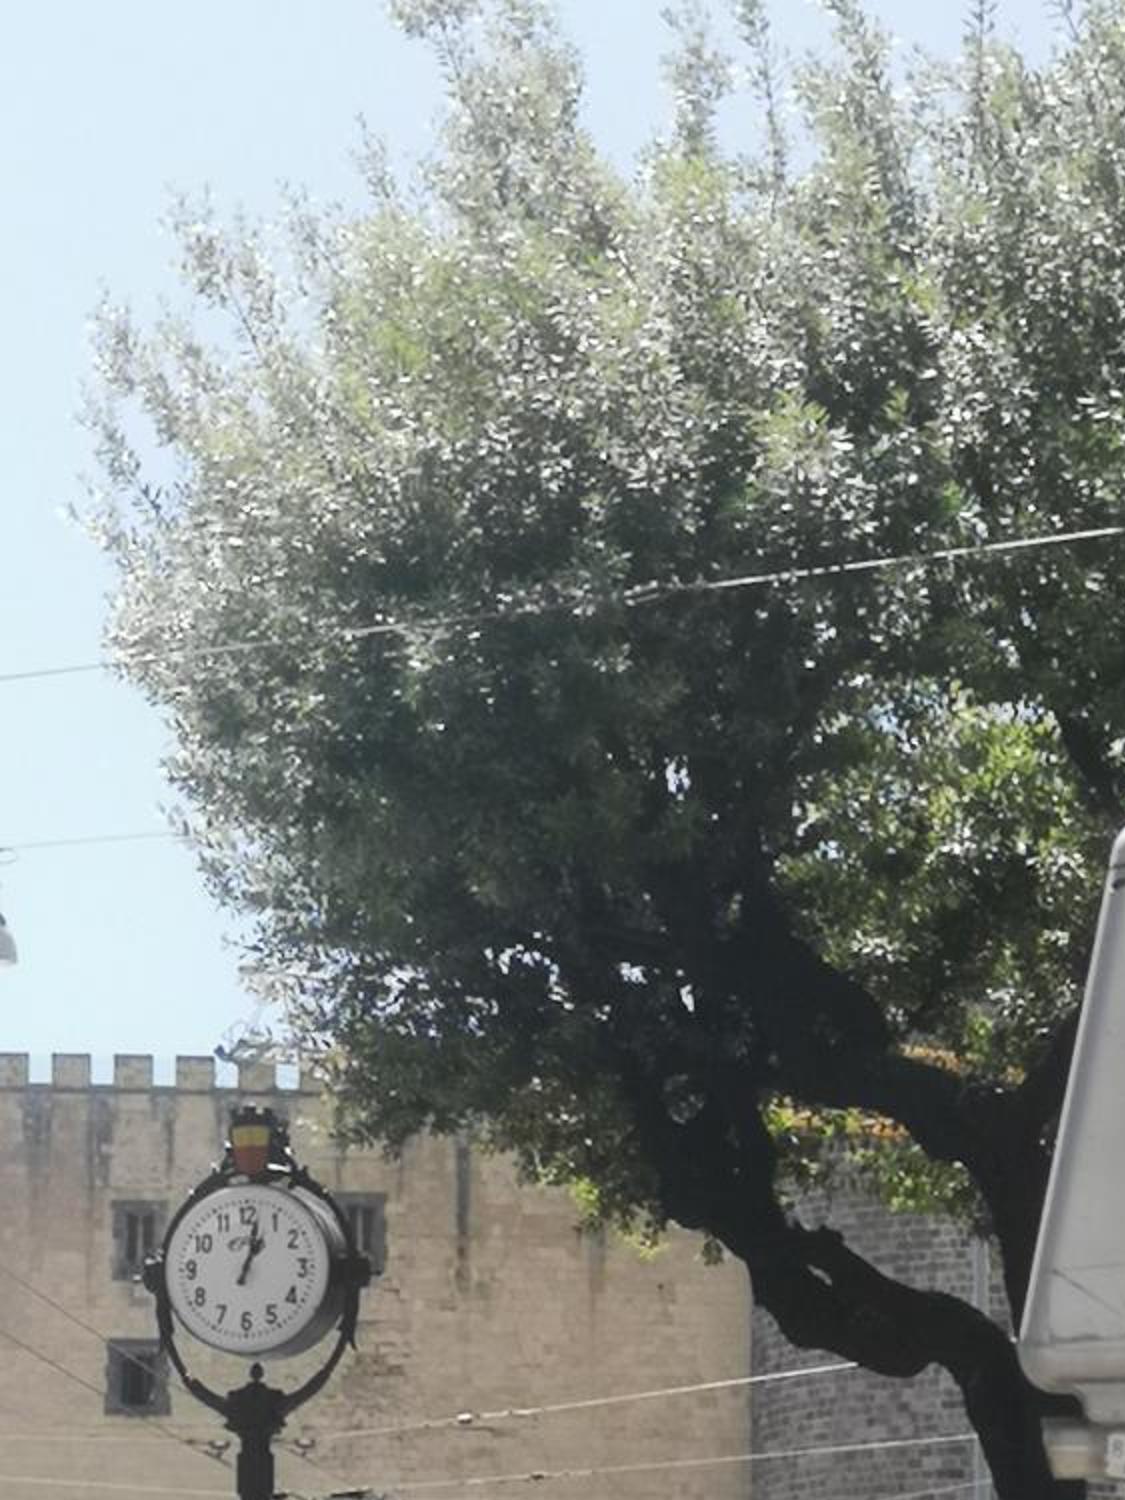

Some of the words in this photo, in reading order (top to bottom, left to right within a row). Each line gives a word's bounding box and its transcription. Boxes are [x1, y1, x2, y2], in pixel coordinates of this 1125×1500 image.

[217, 1214, 230, 1232] 11
[240, 1207, 257, 1225] 12
[272, 1214, 279, 1232] 1
[195, 1234, 213, 1253] 10
[287, 1229, 299, 1249] 2
[186, 1260, 197, 1280] 9
[297, 1258, 307, 1278] 3
[194, 1287, 206, 1306] 8
[285, 1285, 297, 1304] 4
[216, 1304, 227, 1324] 7
[241, 1312, 253, 1331] 6
[265, 1304, 278, 1324] 5
